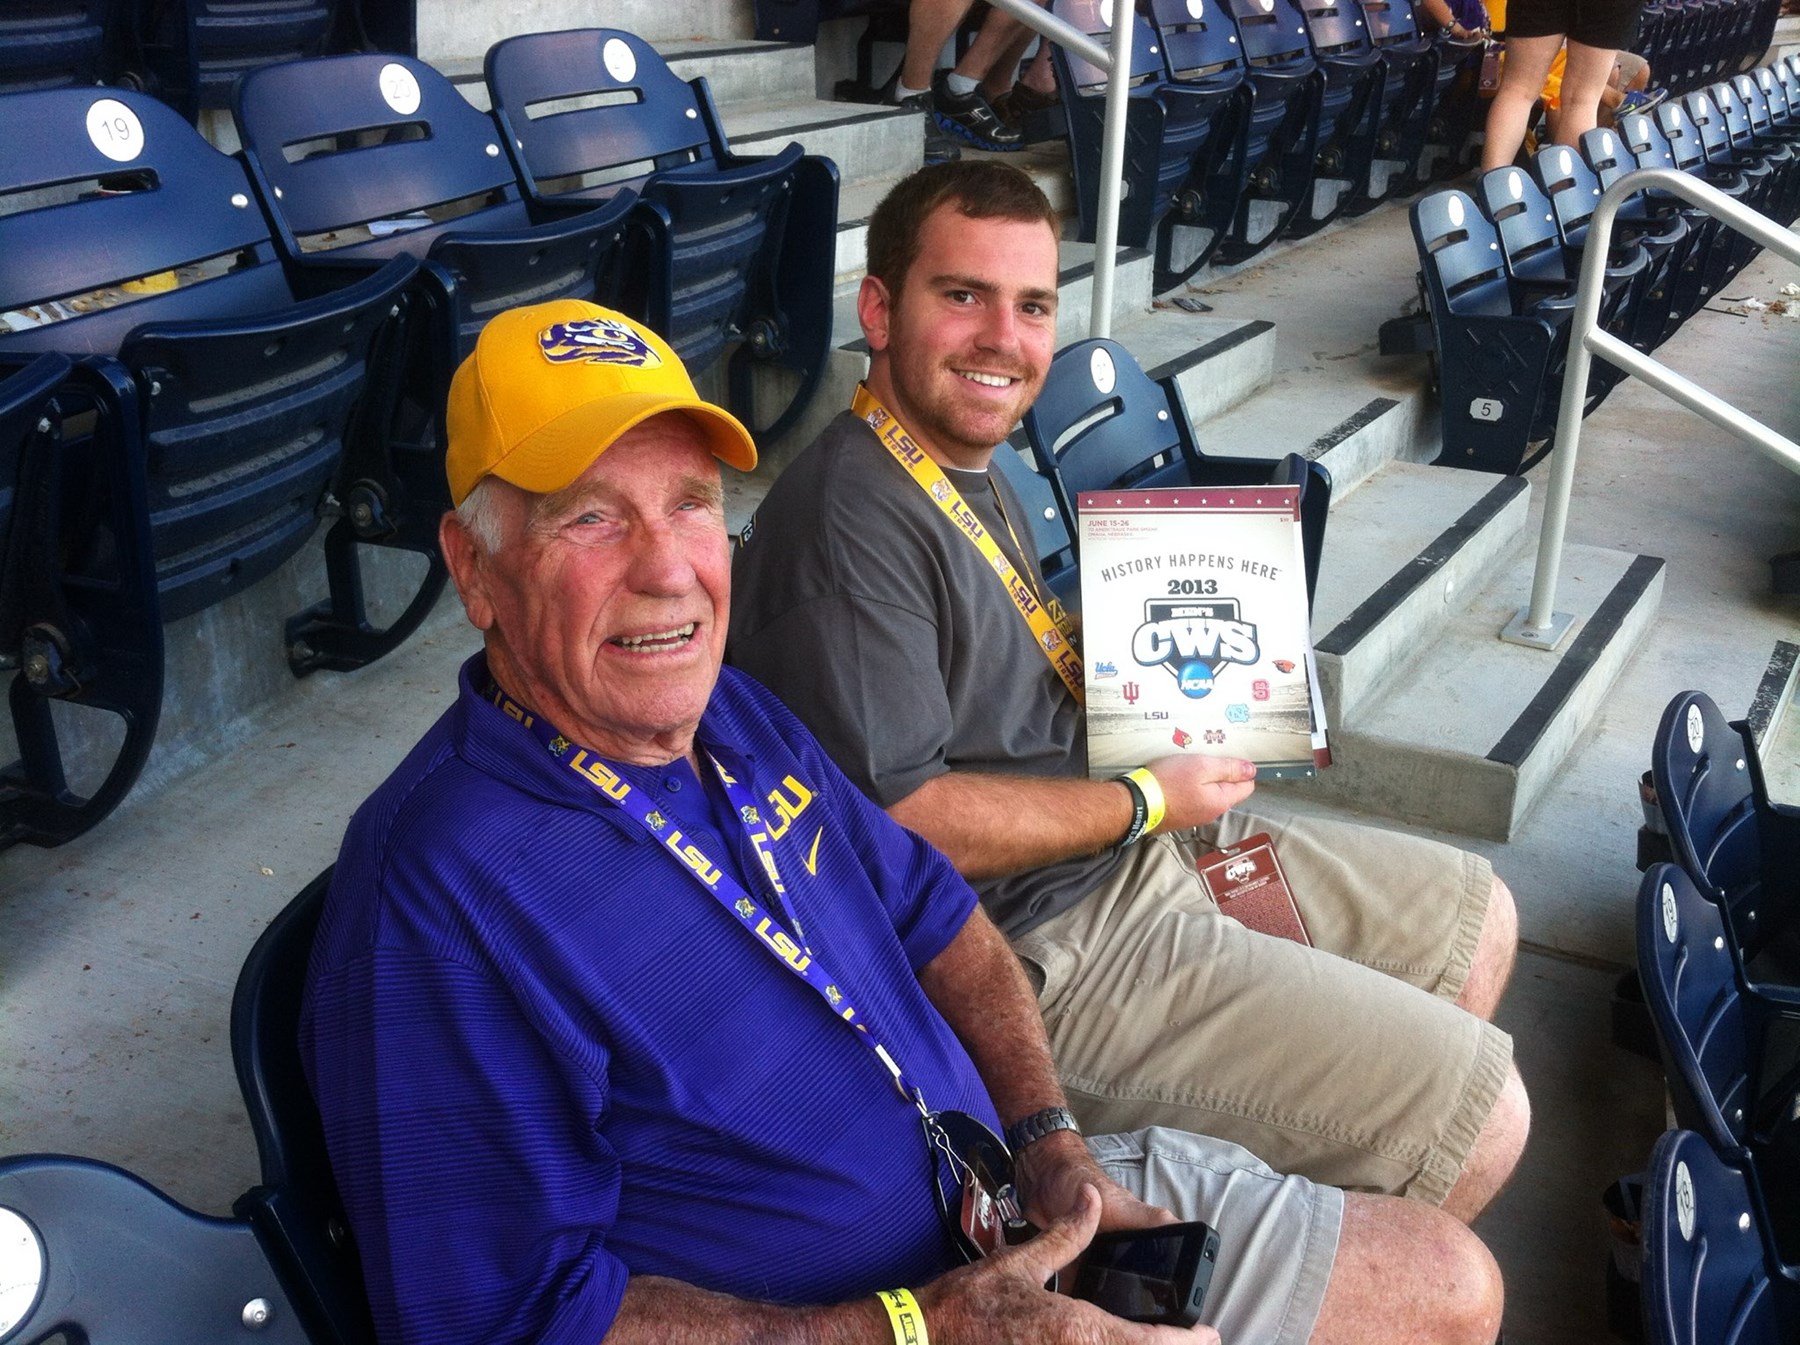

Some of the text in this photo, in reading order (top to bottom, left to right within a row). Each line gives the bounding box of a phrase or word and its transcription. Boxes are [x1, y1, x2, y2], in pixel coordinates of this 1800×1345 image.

[101, 117, 130, 141] 19
[1481, 402, 1492, 417] 5
[883, 435, 914, 469] TIGERS
[886, 425, 925, 465] LSU
[951, 500, 984, 538] LSU
[1101, 553, 1279, 583] HISTORY HAPPENS HERE
[1010, 576, 1038, 614] LSU
[1167, 579, 1218, 595] 2013
[1132, 618, 1260, 667] CWS
[1144, 711, 1169, 720] LSU
[1690, 717, 1700, 741] 20
[569, 750, 632, 801] LSU
[665, 830, 723, 885] LSU
[750, 832, 785, 893] LSU
[754, 917, 812, 972] LSU
[1680, 1180, 1690, 1217] 18
